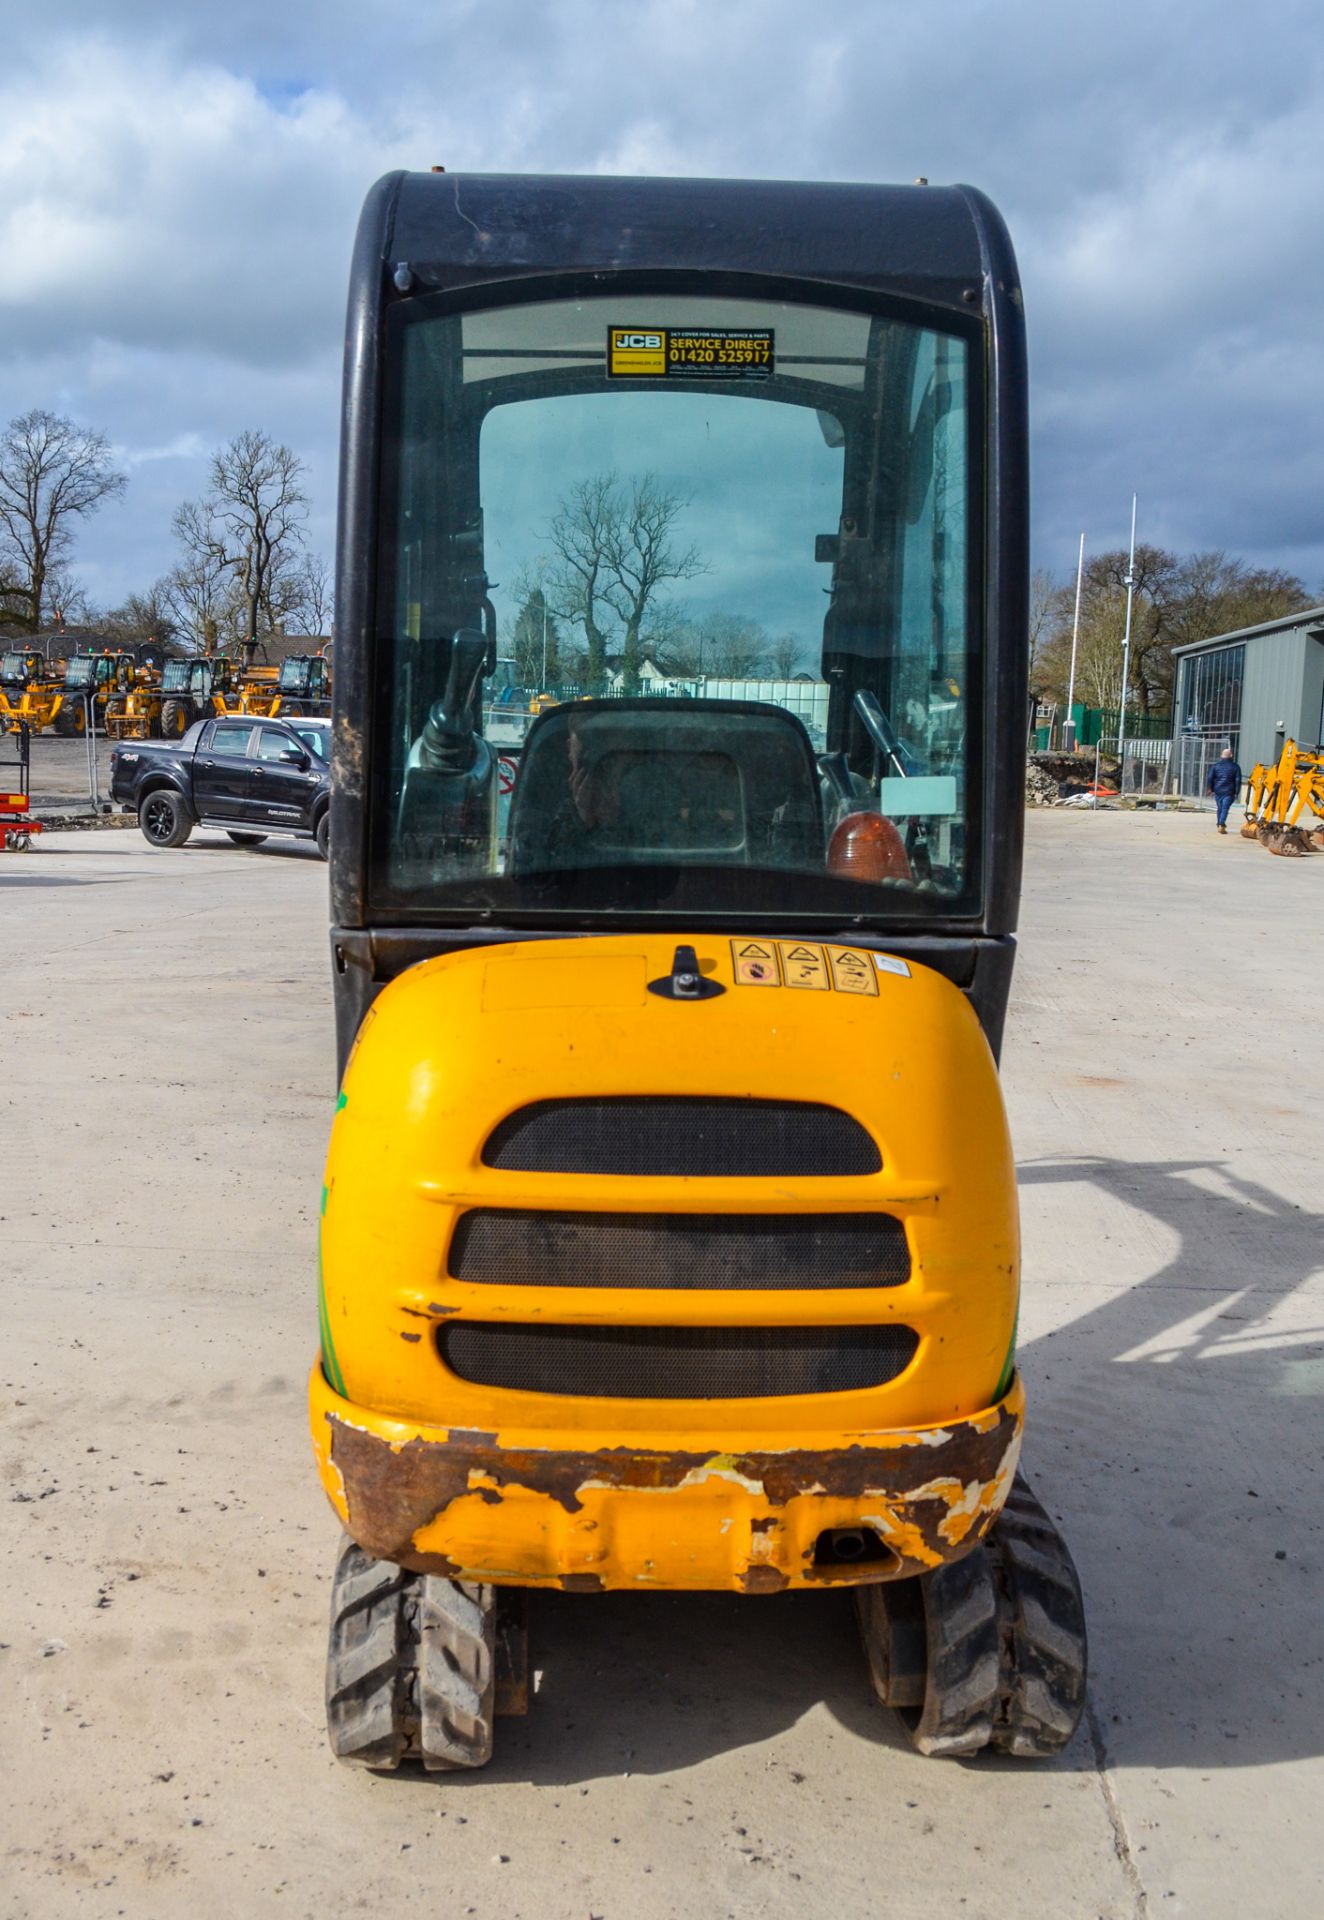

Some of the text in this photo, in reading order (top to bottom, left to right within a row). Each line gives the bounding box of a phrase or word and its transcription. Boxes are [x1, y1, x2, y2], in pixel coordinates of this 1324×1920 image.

[616, 334, 661, 348] JCB
[670, 338, 770, 350] SERVICE DIRECT
[669, 350, 769, 363] 01420 525917
